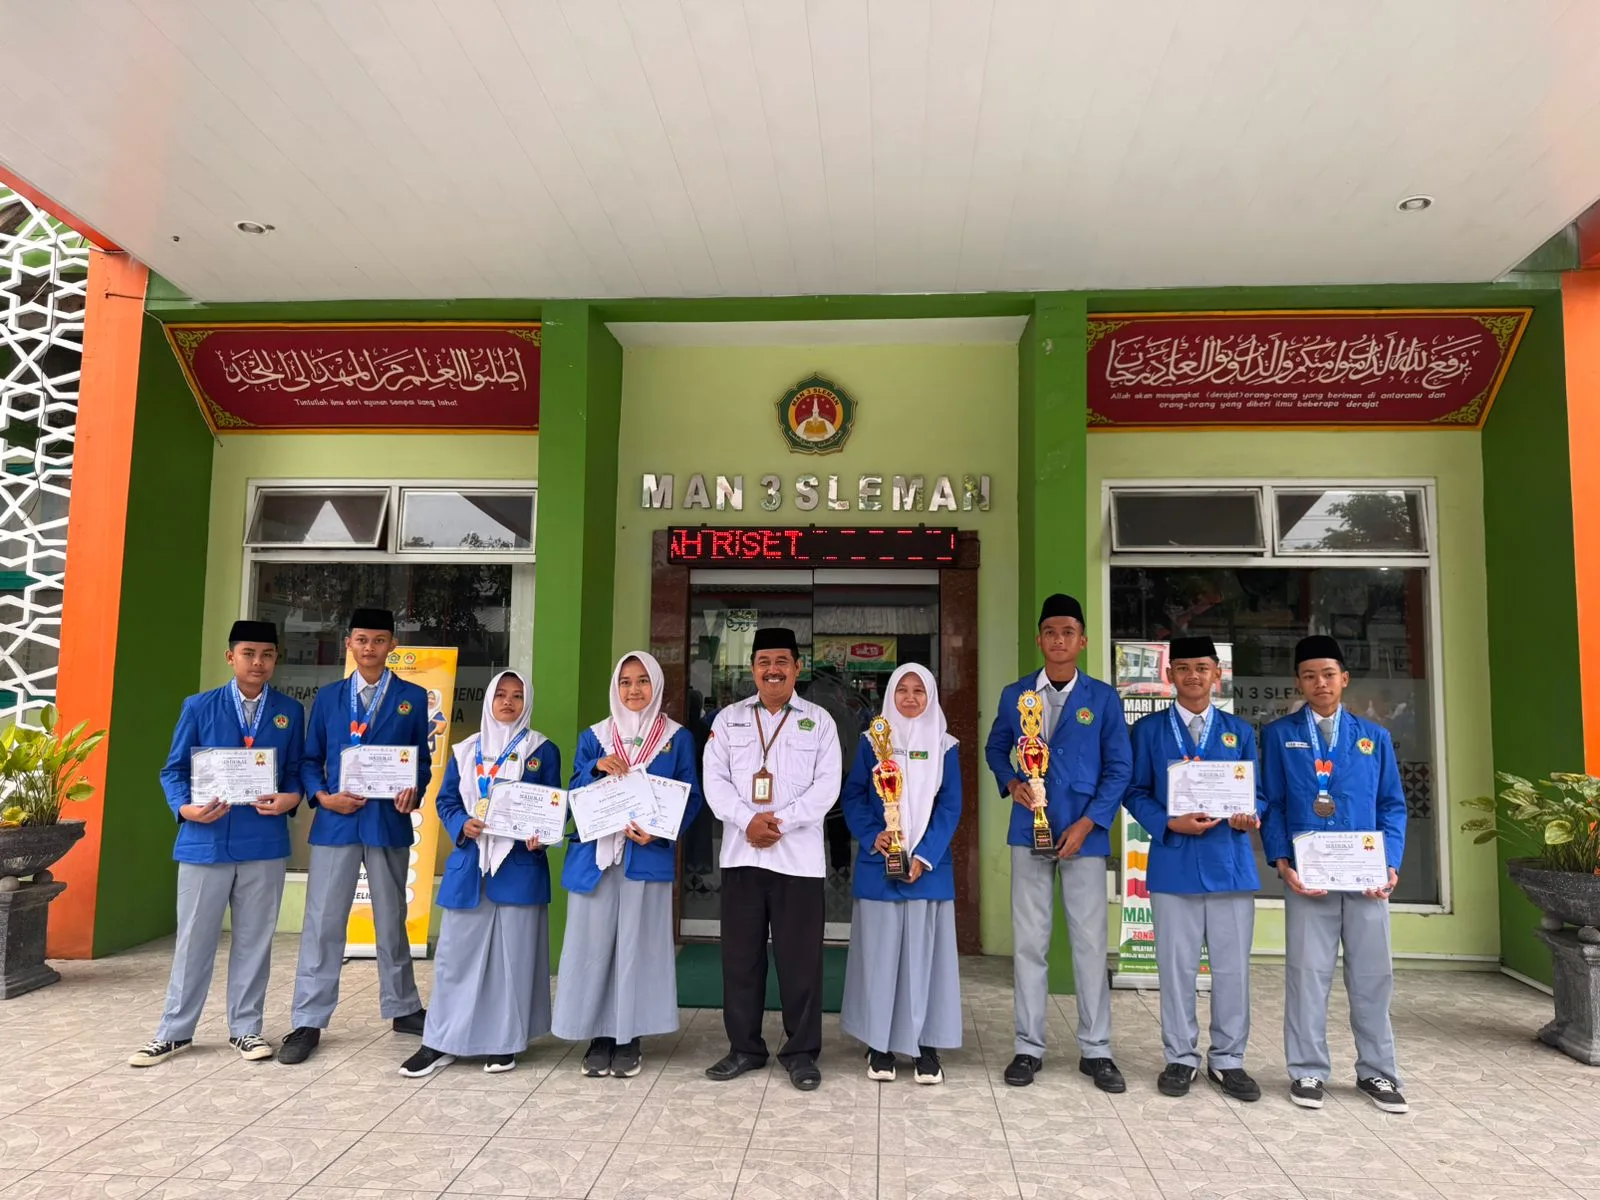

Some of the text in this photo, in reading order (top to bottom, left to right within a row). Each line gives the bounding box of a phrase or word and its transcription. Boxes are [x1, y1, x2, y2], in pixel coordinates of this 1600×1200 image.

[791, 393, 806, 406] MAN
[812, 387, 840, 406] SLEMAN
[1155, 392, 1200, 401] mengangkat
[1302, 392, 1324, 400] yang
[1327, 391, 1362, 399] beriman
[1367, 391, 1376, 399] di
[1381, 391, 1423, 399] antaramu
[1428, 391, 1447, 399] dan
[1220, 402, 1242, 410] yang
[1297, 401, 1339, 409] beberapa
[1346, 401, 1380, 409] derajat
[641, 473, 992, 512] MAN 3 SLEMAN
[712, 529, 803, 556] RISET
[1249, 686, 1259, 699] 3
[1124, 699, 1174, 712] MARI KIT
[1132, 930, 1155, 940] ZONA
